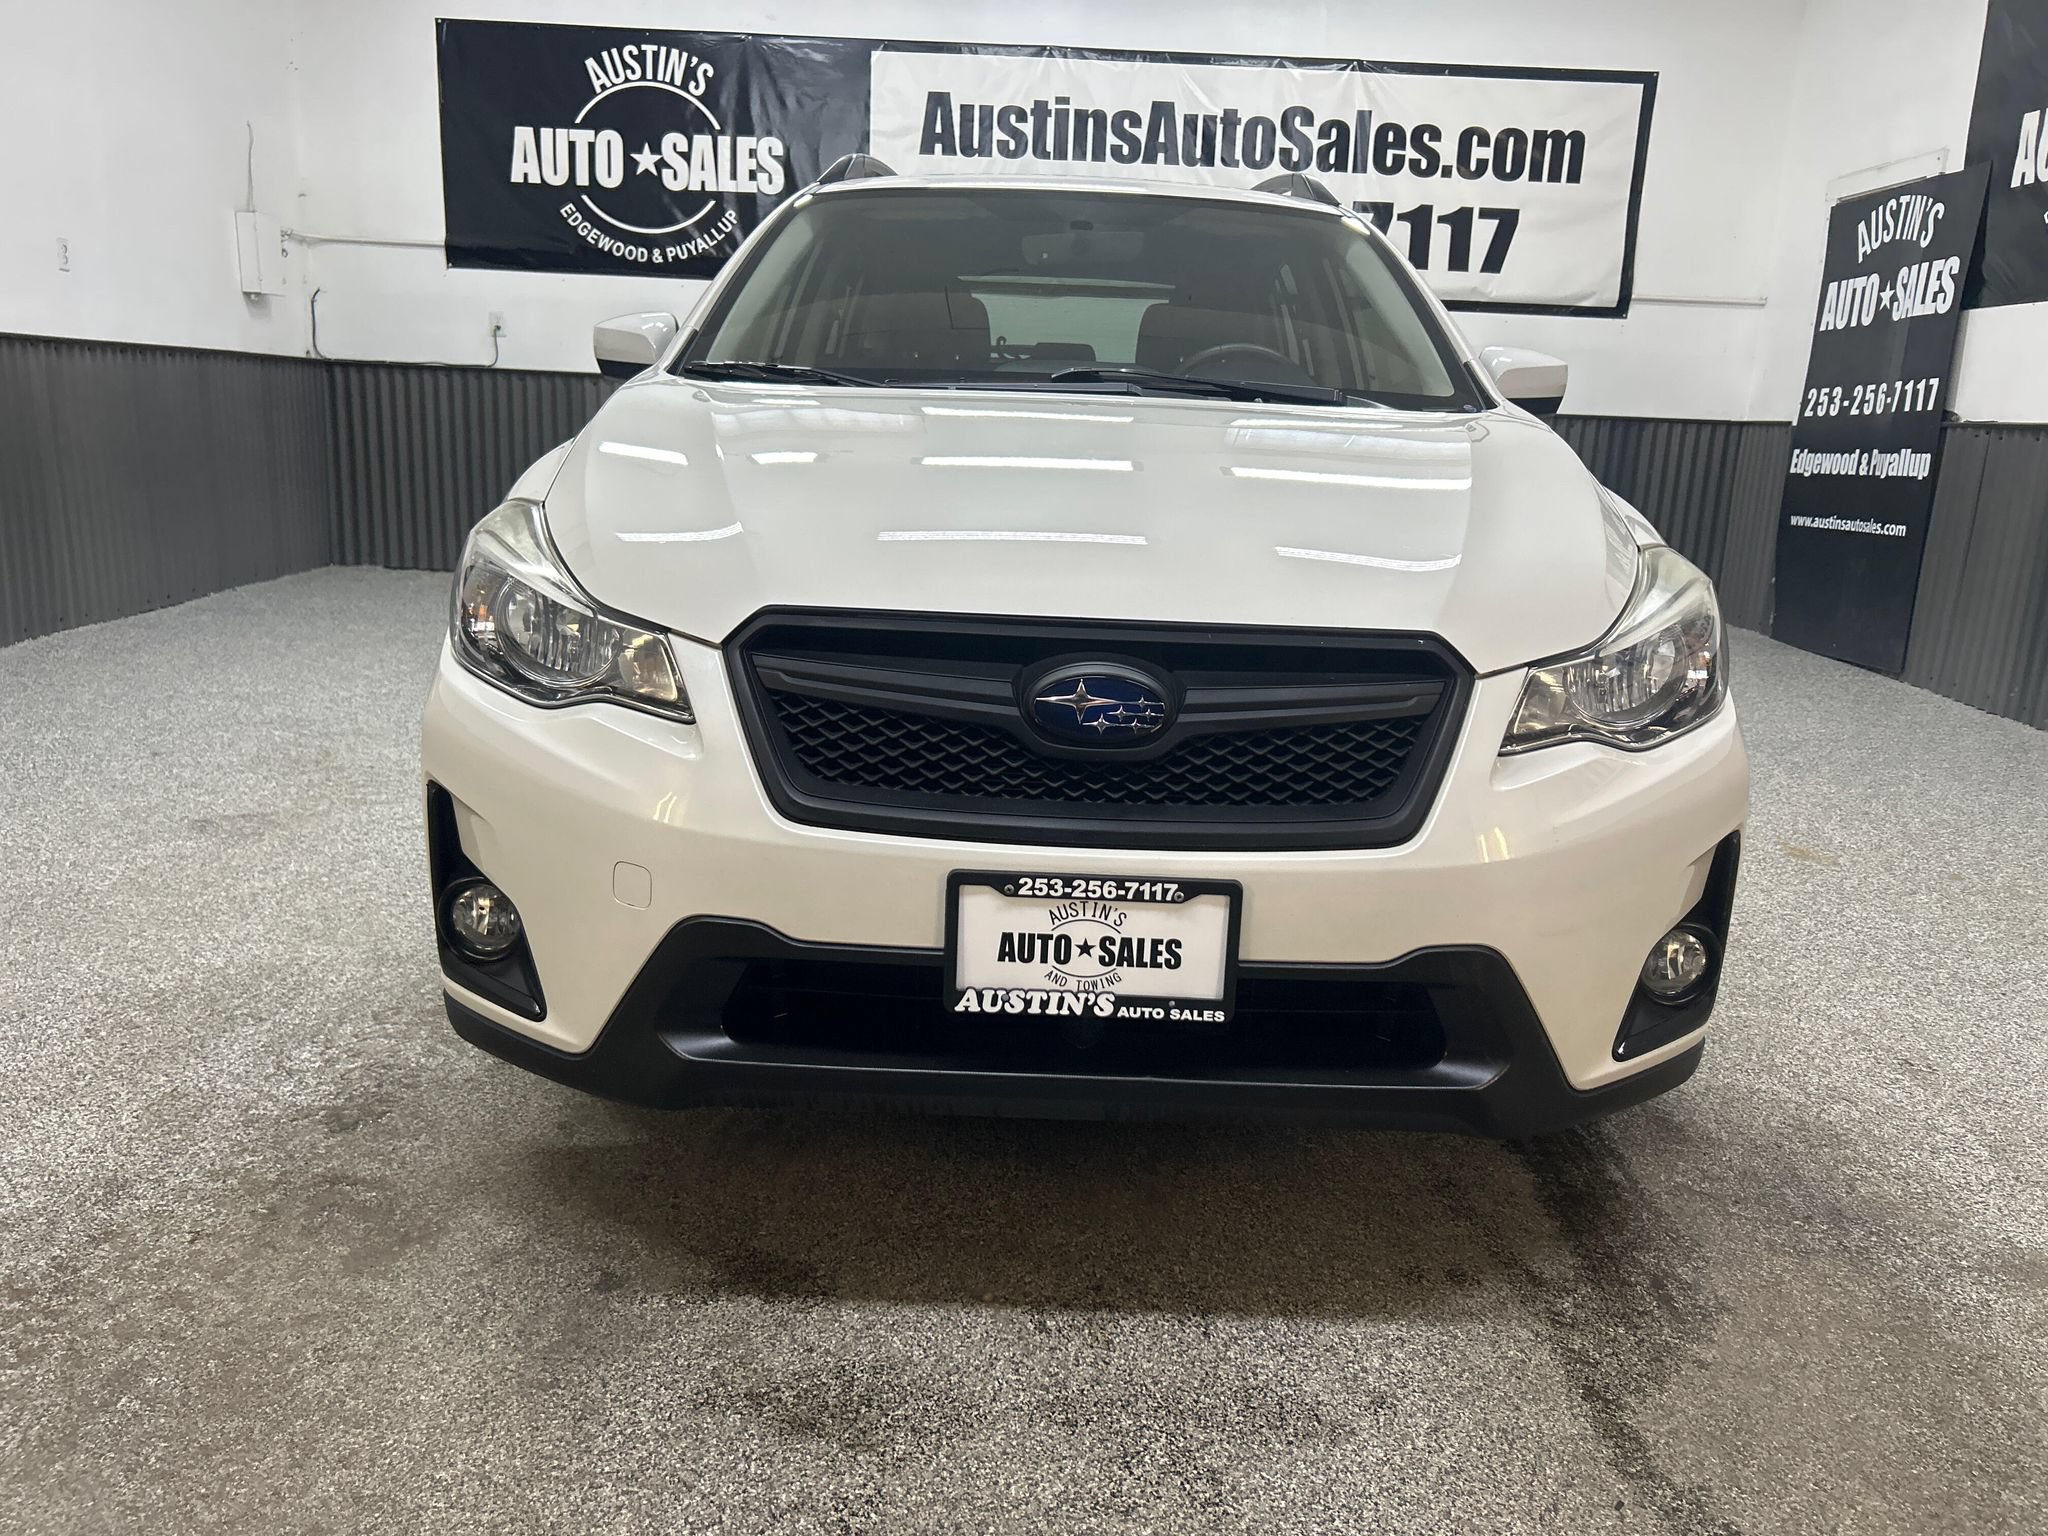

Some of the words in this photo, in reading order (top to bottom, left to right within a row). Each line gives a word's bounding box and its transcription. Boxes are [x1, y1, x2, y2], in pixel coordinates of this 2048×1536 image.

[584, 44, 714, 97] AUSTIN'S
[918, 91, 1586, 184] AustinsAutoSales.com
[510, 126, 624, 189] AUTO
[660, 132, 785, 195] SALES
[559, 202, 649, 263] EDGEWOOD
[652, 249, 664, 263] &
[665, 209, 740, 263] PUYALLUP
[1857, 194, 1945, 264] AUSTIN'S
[1819, 273, 1880, 332] AUTO
[1892, 255, 1961, 322] SALES
[1804, 377, 1940, 417] 253-256-7117
[1790, 448, 1860, 477] Edgewood
[1859, 452, 1869, 476] &
[1868, 448, 1932, 480] Puyallup
[1790, 514, 1907, 537] www.austinsautosales.com
[1017, 877, 1179, 902] 253-256-7117
[1048, 900, 1127, 928] AUSTIN'S
[997, 931, 1072, 965] AUTO
[1098, 935, 1182, 970] SALES
[1044, 970, 1068, 988] AND
[1075, 971, 1122, 992] TOWING
[954, 987, 1116, 1018] AUSTIN'S
[1117, 1005, 1165, 1020] AUTO
[1168, 1007, 1226, 1023] SALES
